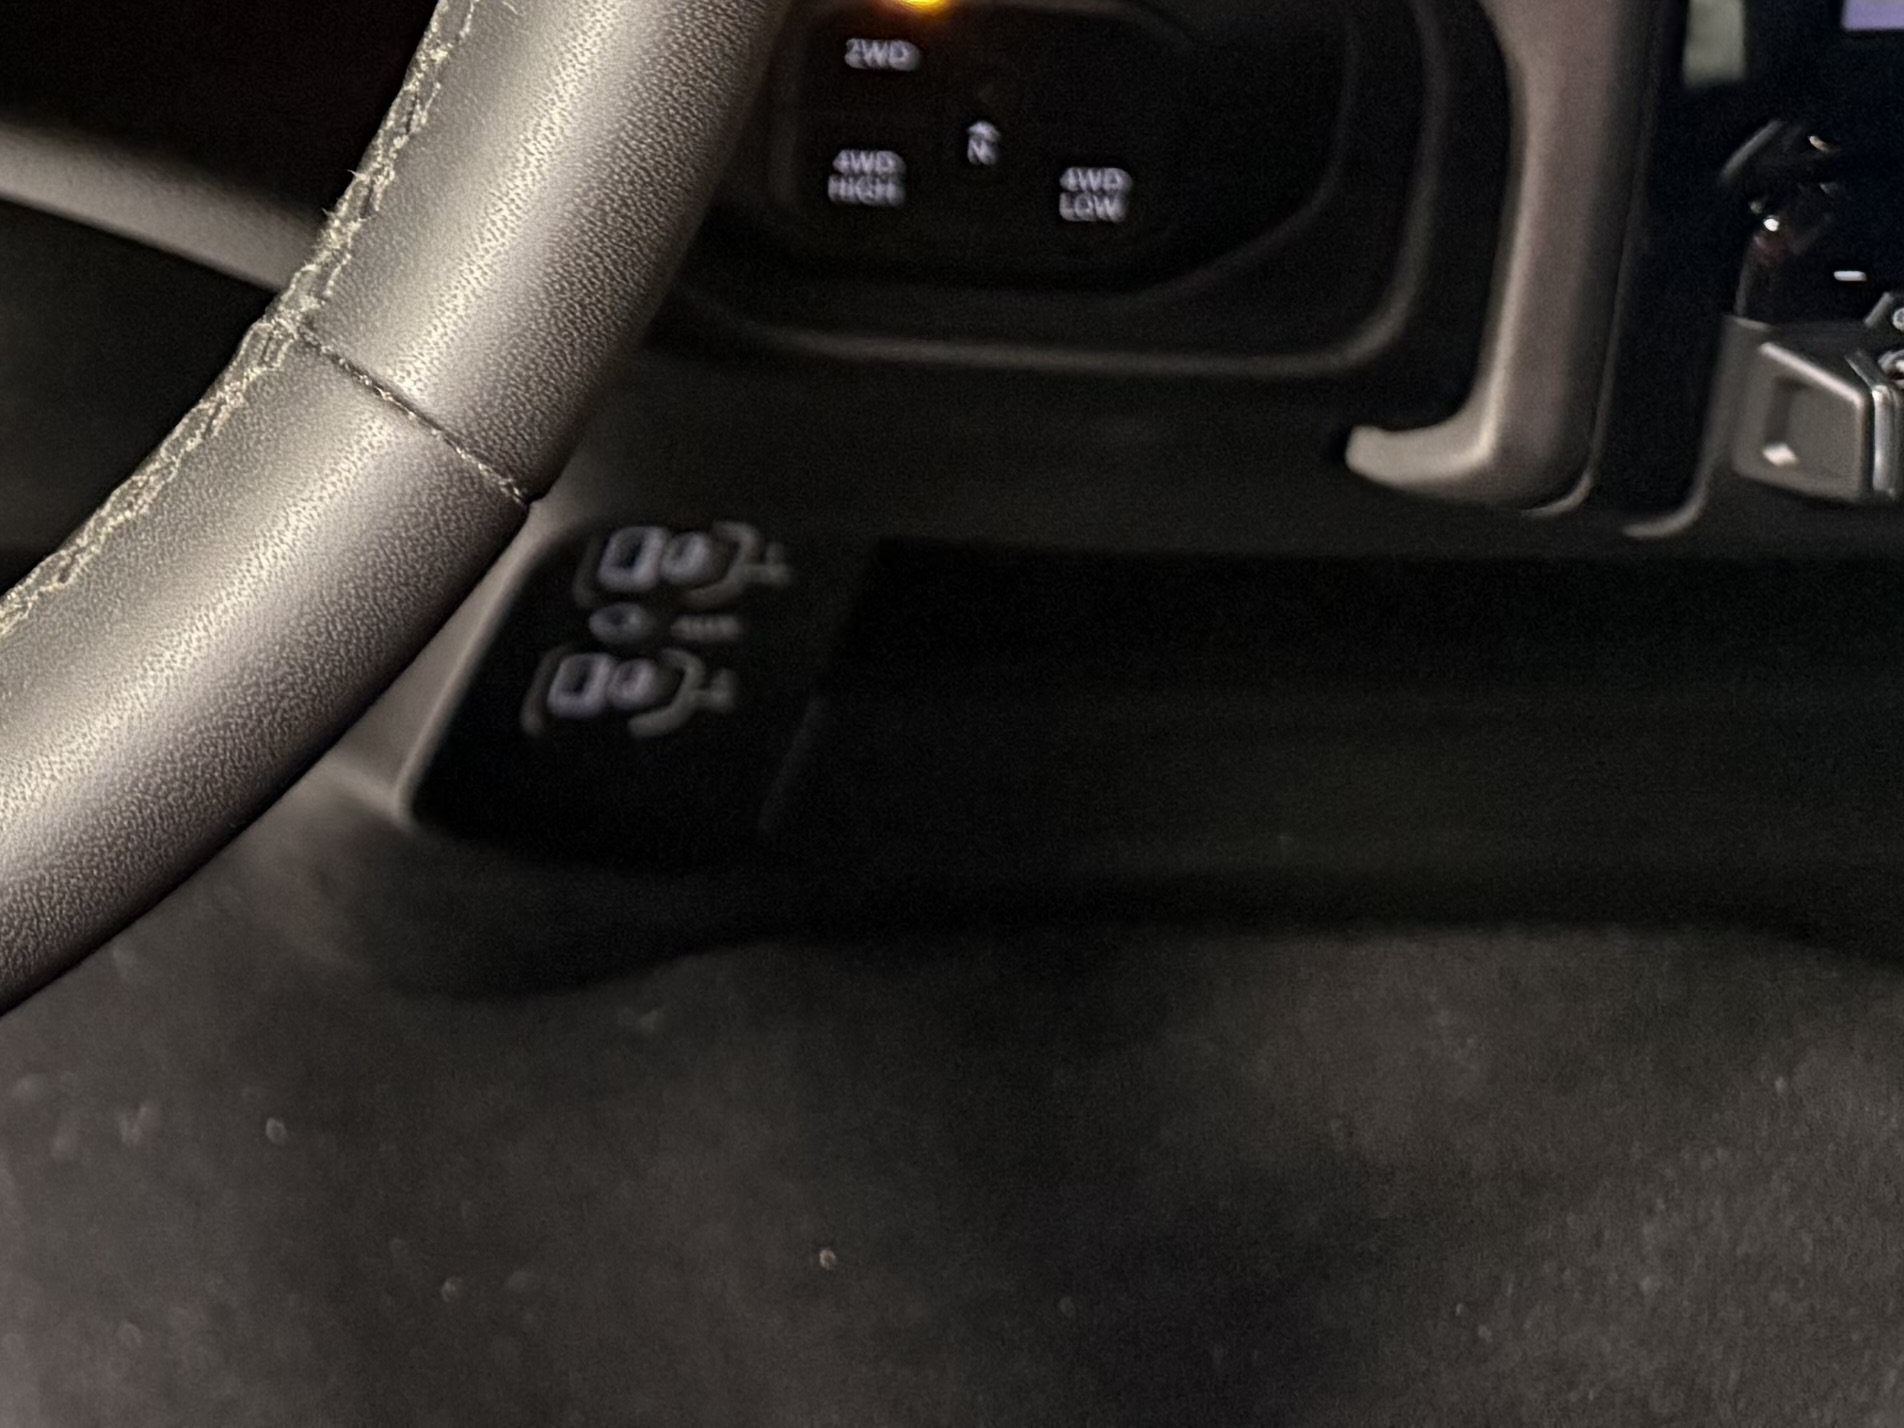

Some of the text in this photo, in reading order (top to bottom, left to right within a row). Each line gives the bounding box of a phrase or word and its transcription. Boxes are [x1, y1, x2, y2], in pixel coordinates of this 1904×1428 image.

[843, 37, 922, 72] 2WD
[1059, 166, 1134, 193] 4WD
[1058, 190, 1130, 223] LOW
